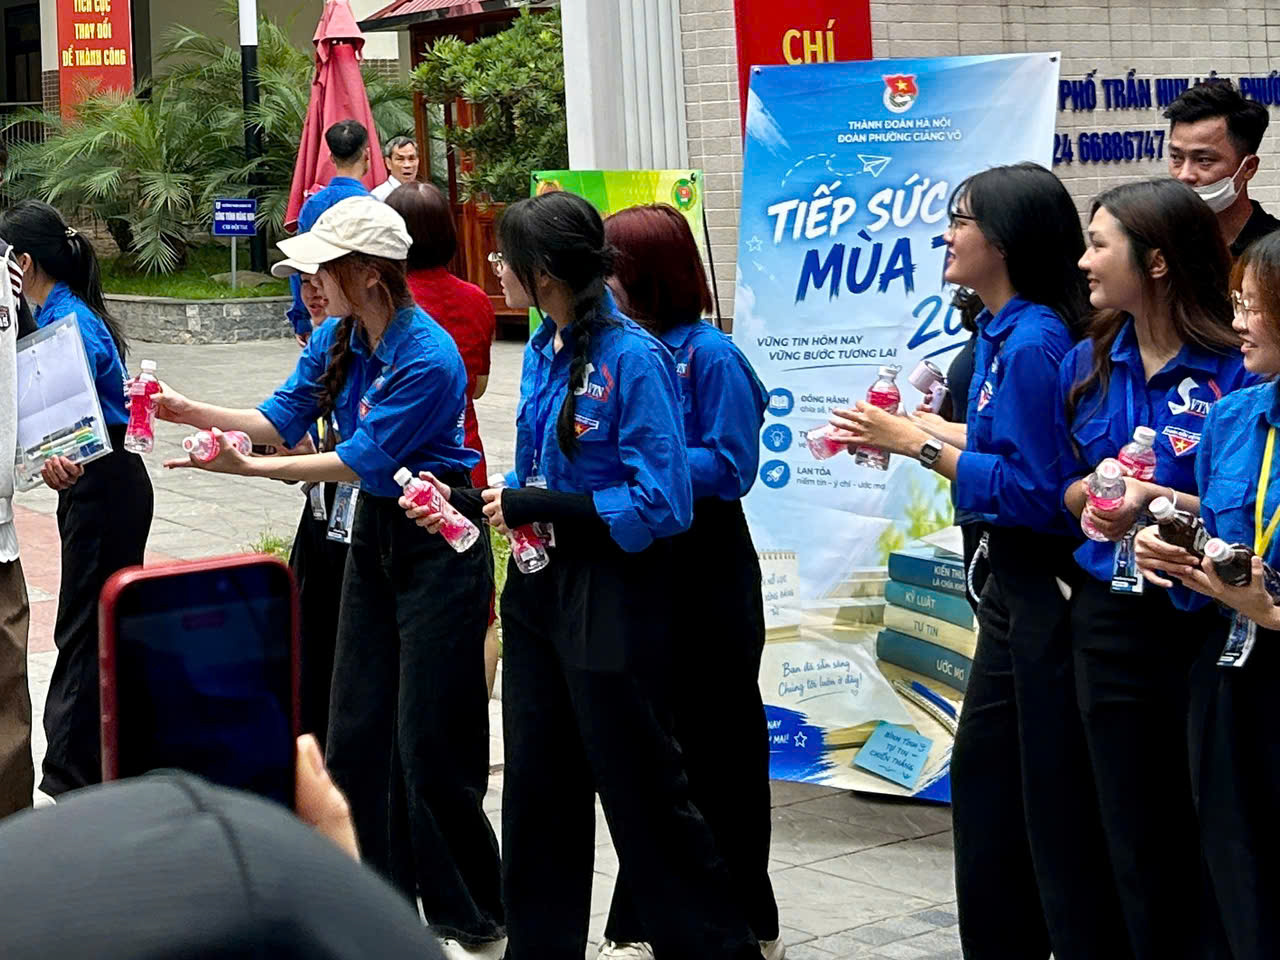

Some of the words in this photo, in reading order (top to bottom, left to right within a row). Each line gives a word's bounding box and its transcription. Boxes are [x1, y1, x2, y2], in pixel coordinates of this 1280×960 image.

[75, 23, 95, 40] THAY
[782, 19, 836, 64] CHÍ
[75, 47, 102, 66] THÀNH
[104, 49, 126, 66] CÔNG
[1059, 69, 1097, 111] PHỐ
[1102, 69, 1152, 110] TRẦN
[848, 119, 882, 129] THÀNH
[884, 118, 914, 129] ĐOÀN
[916, 118, 931, 128] HÀ
[932, 117, 951, 130] NỘI
[837, 132, 866, 143] ĐOÀN
[869, 131, 911, 142] PHƯỜNG
[913, 130, 945, 141] GIẢNG
[947, 129, 962, 140] VÕ
[767, 180, 857, 244] TIẾP
[866, 173, 949, 232] SỨC
[795, 229, 917, 306] MÙA
[757, 335, 788, 346] VỮNG
[792, 337, 809, 346] TIN
[812, 334, 838, 346] HÔM
[840, 335, 863, 345] NAY
[769, 349, 800, 360] VỮNG
[803, 348, 836, 360] BƯỚC
[838, 349, 877, 359] TƯƠNG
[879, 348, 897, 358] LAI
[797, 467, 813, 476] LAN
[934, 564, 951, 577] KIẾN
[926, 624, 939, 638] TIN
